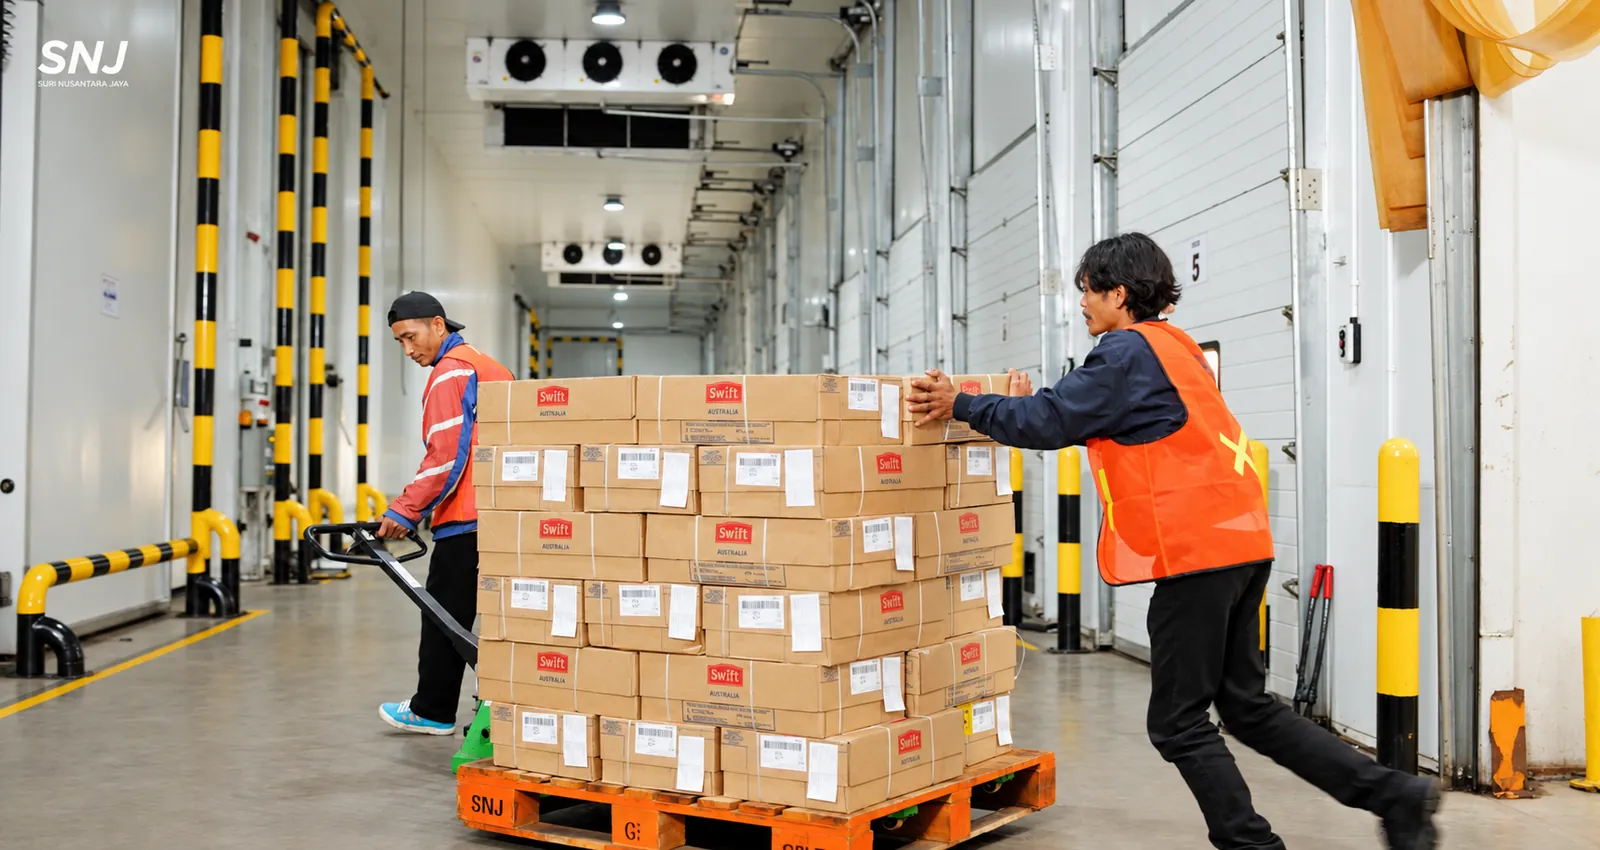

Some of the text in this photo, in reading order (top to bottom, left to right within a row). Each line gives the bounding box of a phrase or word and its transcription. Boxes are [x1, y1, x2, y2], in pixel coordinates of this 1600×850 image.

[1192, 252, 1200, 282] 5
[539, 390, 566, 403] Swift
[709, 386, 739, 399] Swift
[707, 408, 739, 416] AUSTRALIA
[879, 457, 900, 470] Swift
[542, 523, 570, 536] Swift
[719, 527, 748, 540] Swift
[541, 543, 570, 551] AUSTRALIA
[716, 549, 748, 557] AUSTRALIA
[882, 595, 902, 609] Swift
[539, 656, 566, 669] Swift
[538, 675, 566, 684] AUSTRALIA
[710, 668, 740, 683] Swift
[709, 690, 740, 699] AUSTRALIA
[900, 733, 920, 751] Swift
[471, 794, 504, 817] SNJ
